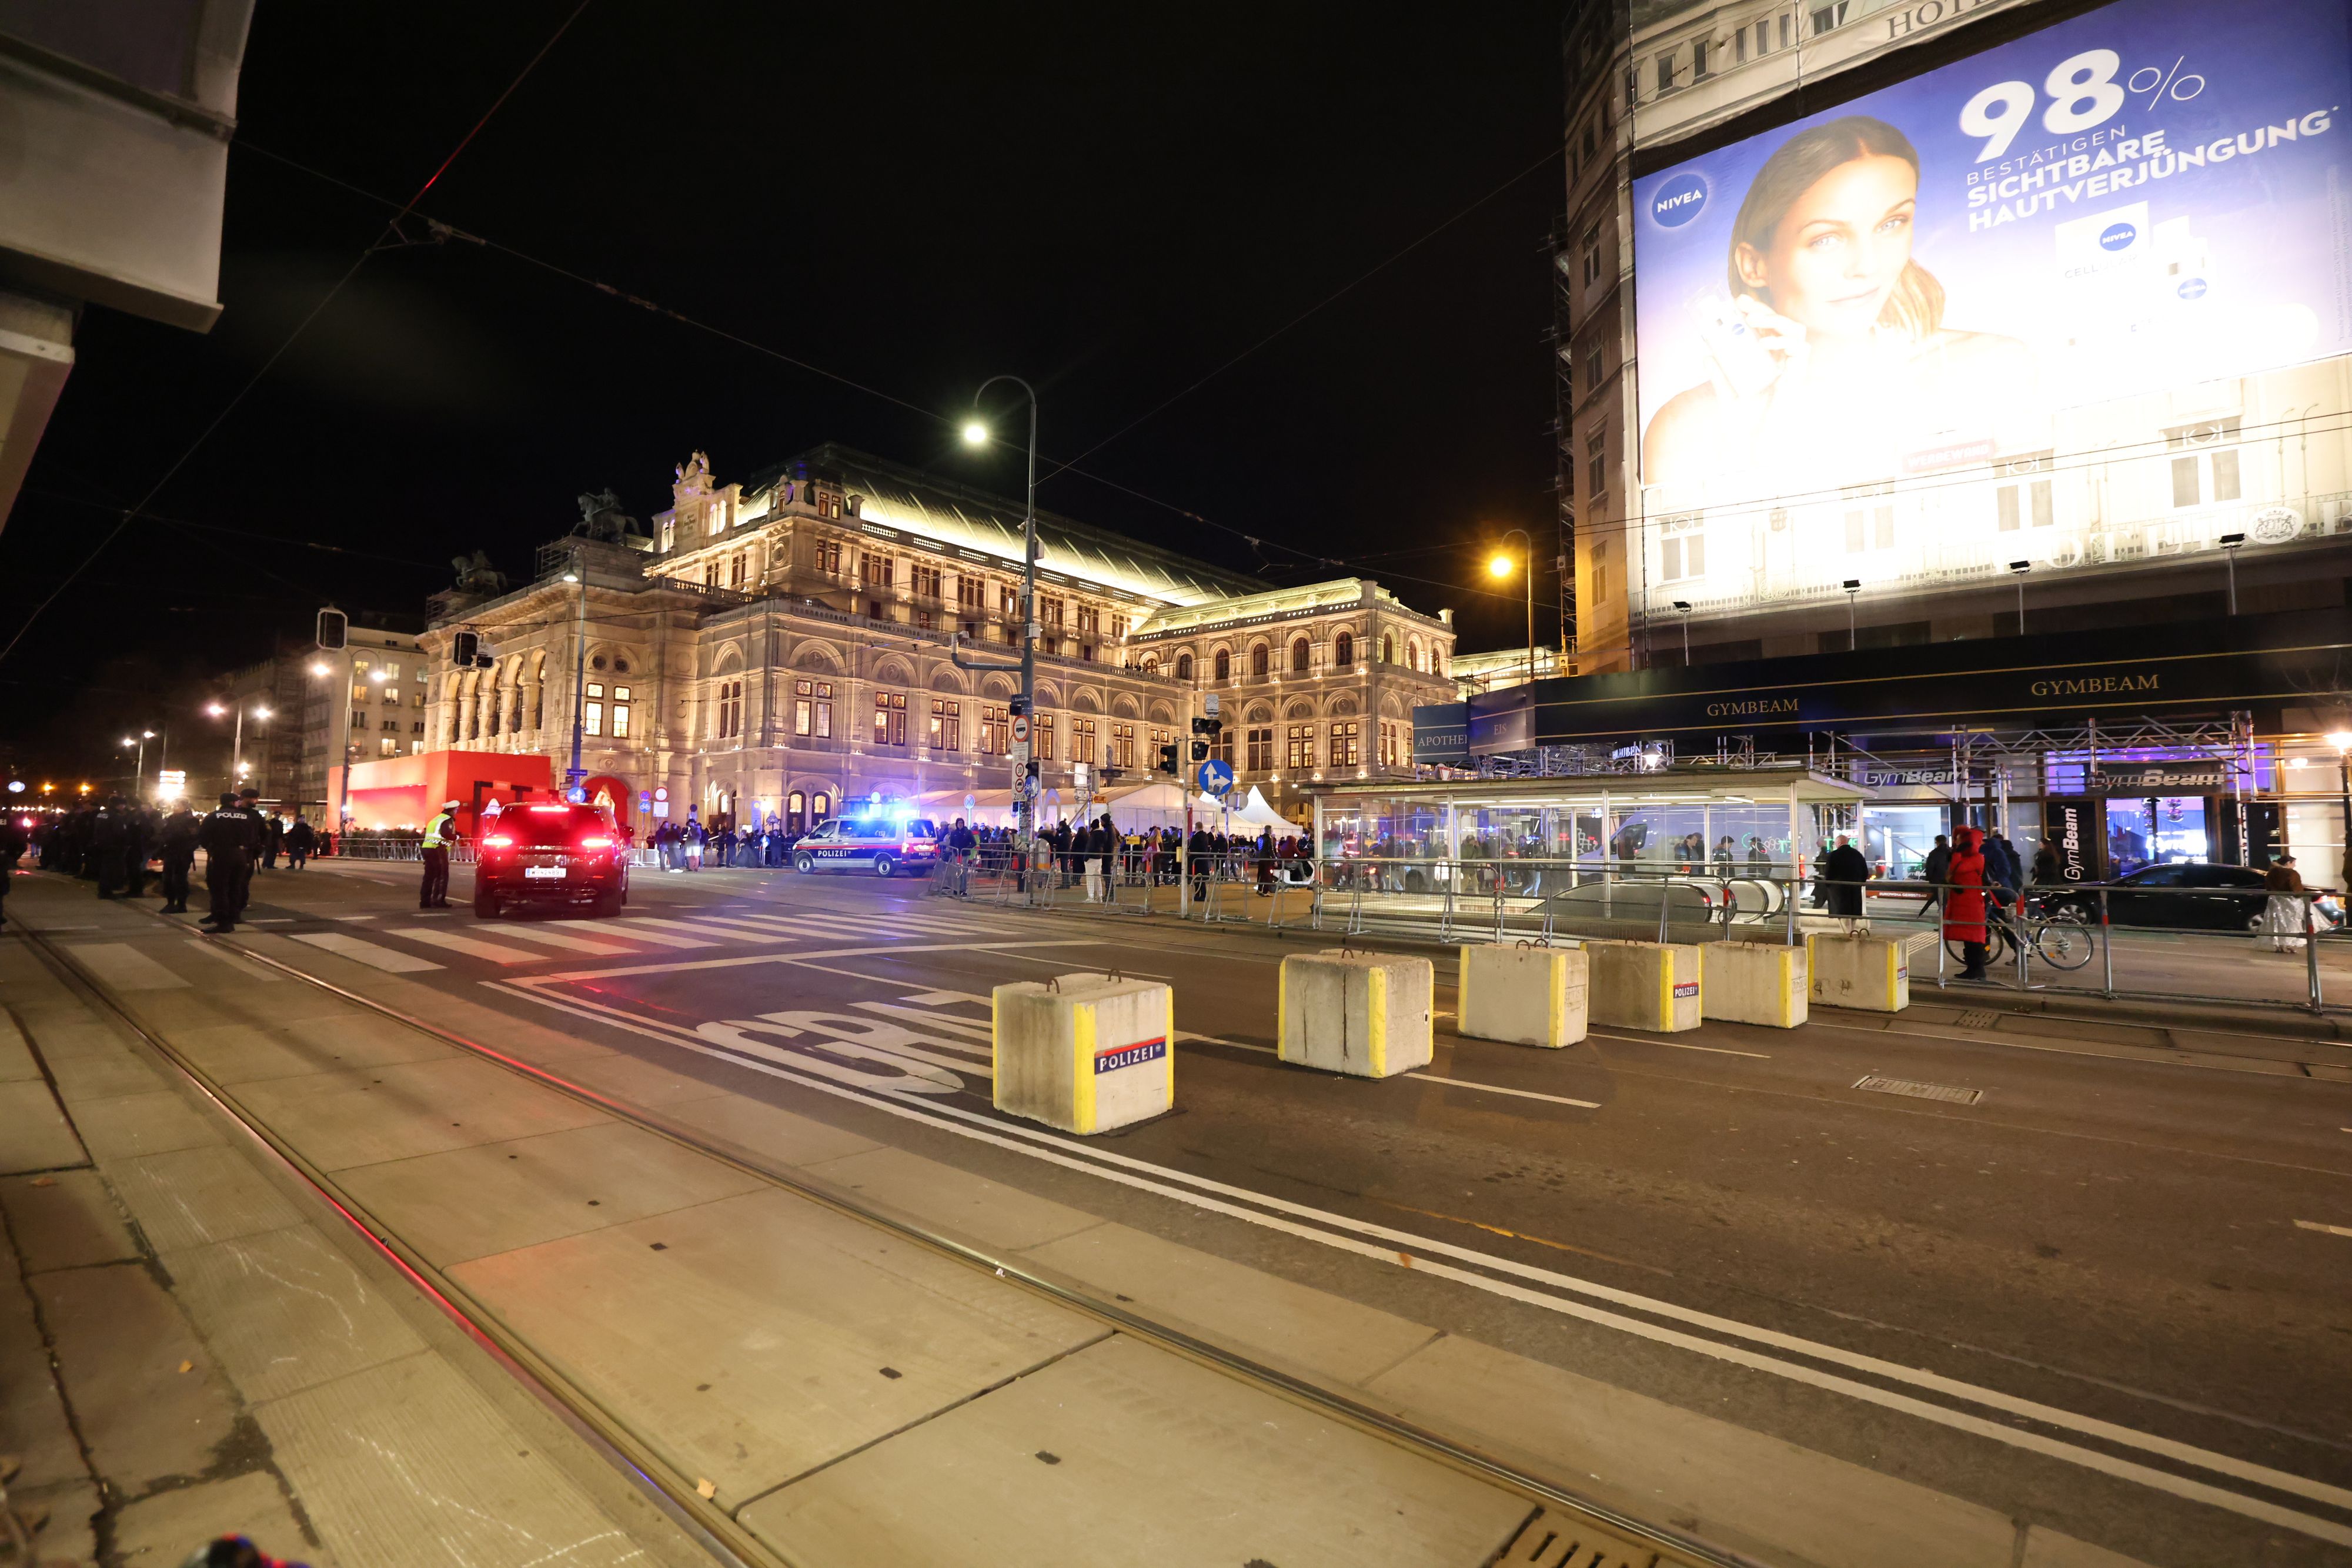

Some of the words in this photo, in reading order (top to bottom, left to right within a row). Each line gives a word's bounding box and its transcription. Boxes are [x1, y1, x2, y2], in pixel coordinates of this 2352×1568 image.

[1967, 125, 2126, 185] BESTÄTIGEN
[1967, 129, 2166, 208] SICHTBARE
[1657, 188, 1702, 213] NIVEA
[2102, 230, 2134, 244] NIVEA
[2032, 674, 2159, 697] GYMBEAM
[1707, 698, 1799, 716] GYMBEAM
[1418, 734, 1466, 747] APOTHE
[1494, 723, 1506, 735] EIS
[2063, 808, 2084, 880] GymBeam
[1675, 987, 1695, 997] POLIZEI
[1100, 1045, 1154, 1072] POLIZEI
